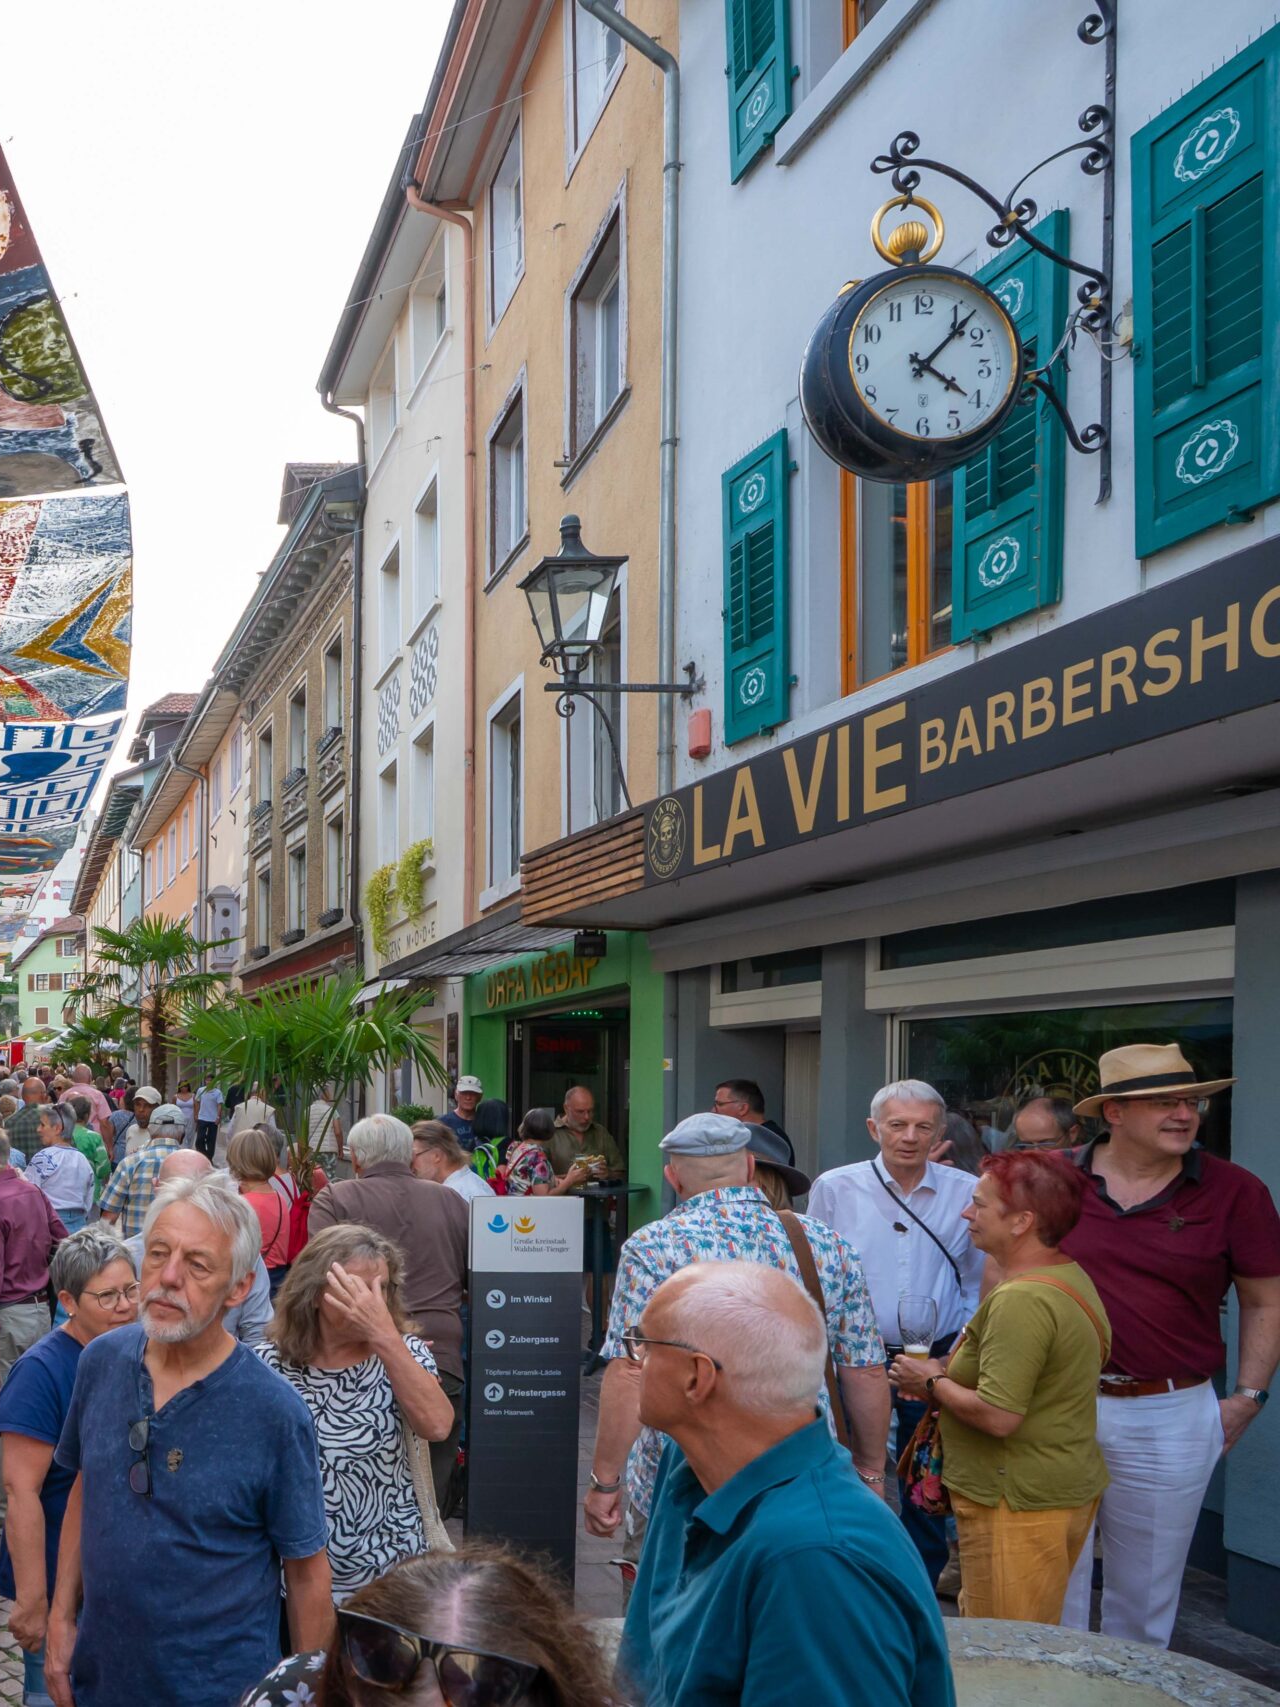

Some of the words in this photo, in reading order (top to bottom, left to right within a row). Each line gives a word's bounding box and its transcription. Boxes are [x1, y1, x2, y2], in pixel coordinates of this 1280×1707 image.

[889, 302, 902, 323] 11
[914, 295, 934, 316] 12
[864, 324, 881, 345] 10
[969, 327, 984, 348] 2
[855, 353, 870, 374] 9
[977, 358, 992, 380] 3
[864, 384, 877, 406] 8
[967, 389, 982, 410] 4
[885, 408, 900, 428] 7
[916, 416, 930, 438] 6
[946, 410, 961, 431] 5
[693, 765, 766, 865] LA
[782, 701, 907, 835] VIE
[655, 806, 664, 822] LA
[665, 801, 678, 814] VIE
[651, 847, 681, 873] BARBERSHOP
[485, 965, 526, 1009] URFA
[531, 951, 599, 998] KEBAP
[510, 1295, 521, 1303] Im
[523, 1295, 552, 1303] Winkel
[509, 1335, 560, 1345] Zubergasse
[508, 1388, 567, 1398] Priestergasse
[483, 1408, 502, 1416] Salon
